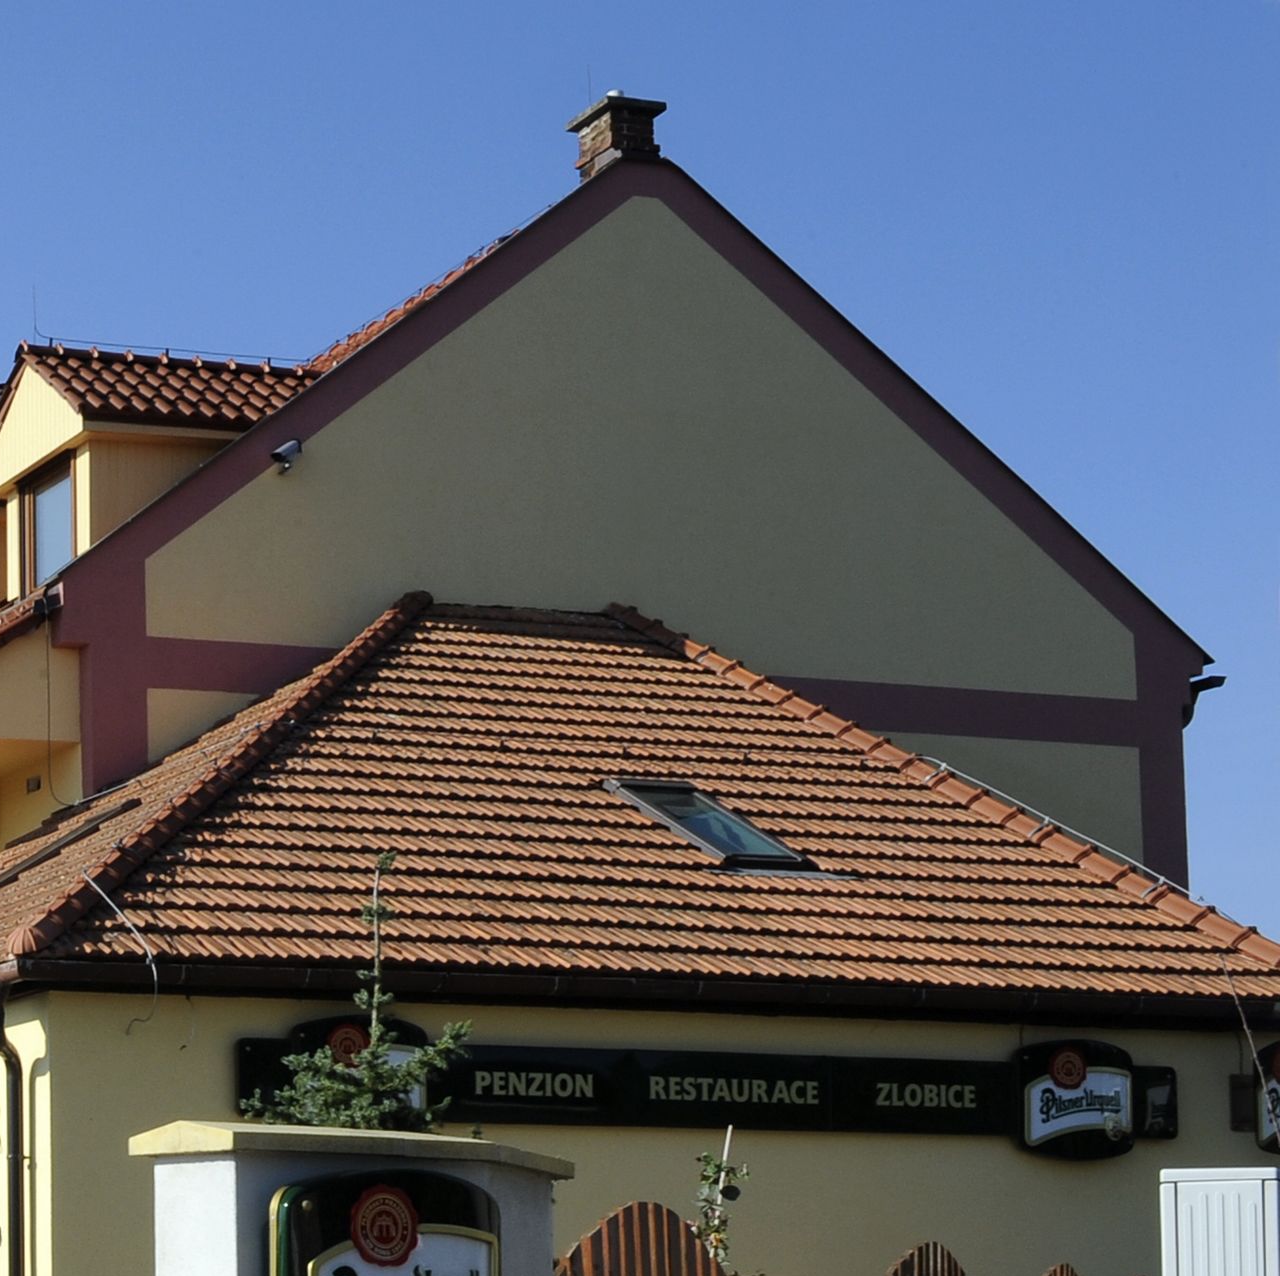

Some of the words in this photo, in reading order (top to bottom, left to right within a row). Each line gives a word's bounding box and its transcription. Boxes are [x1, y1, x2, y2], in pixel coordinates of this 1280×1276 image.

[474, 1070, 595, 1099] PENZION
[648, 1075, 820, 1105] RESTAURACE
[875, 1082, 977, 1109] ZLOBICE
